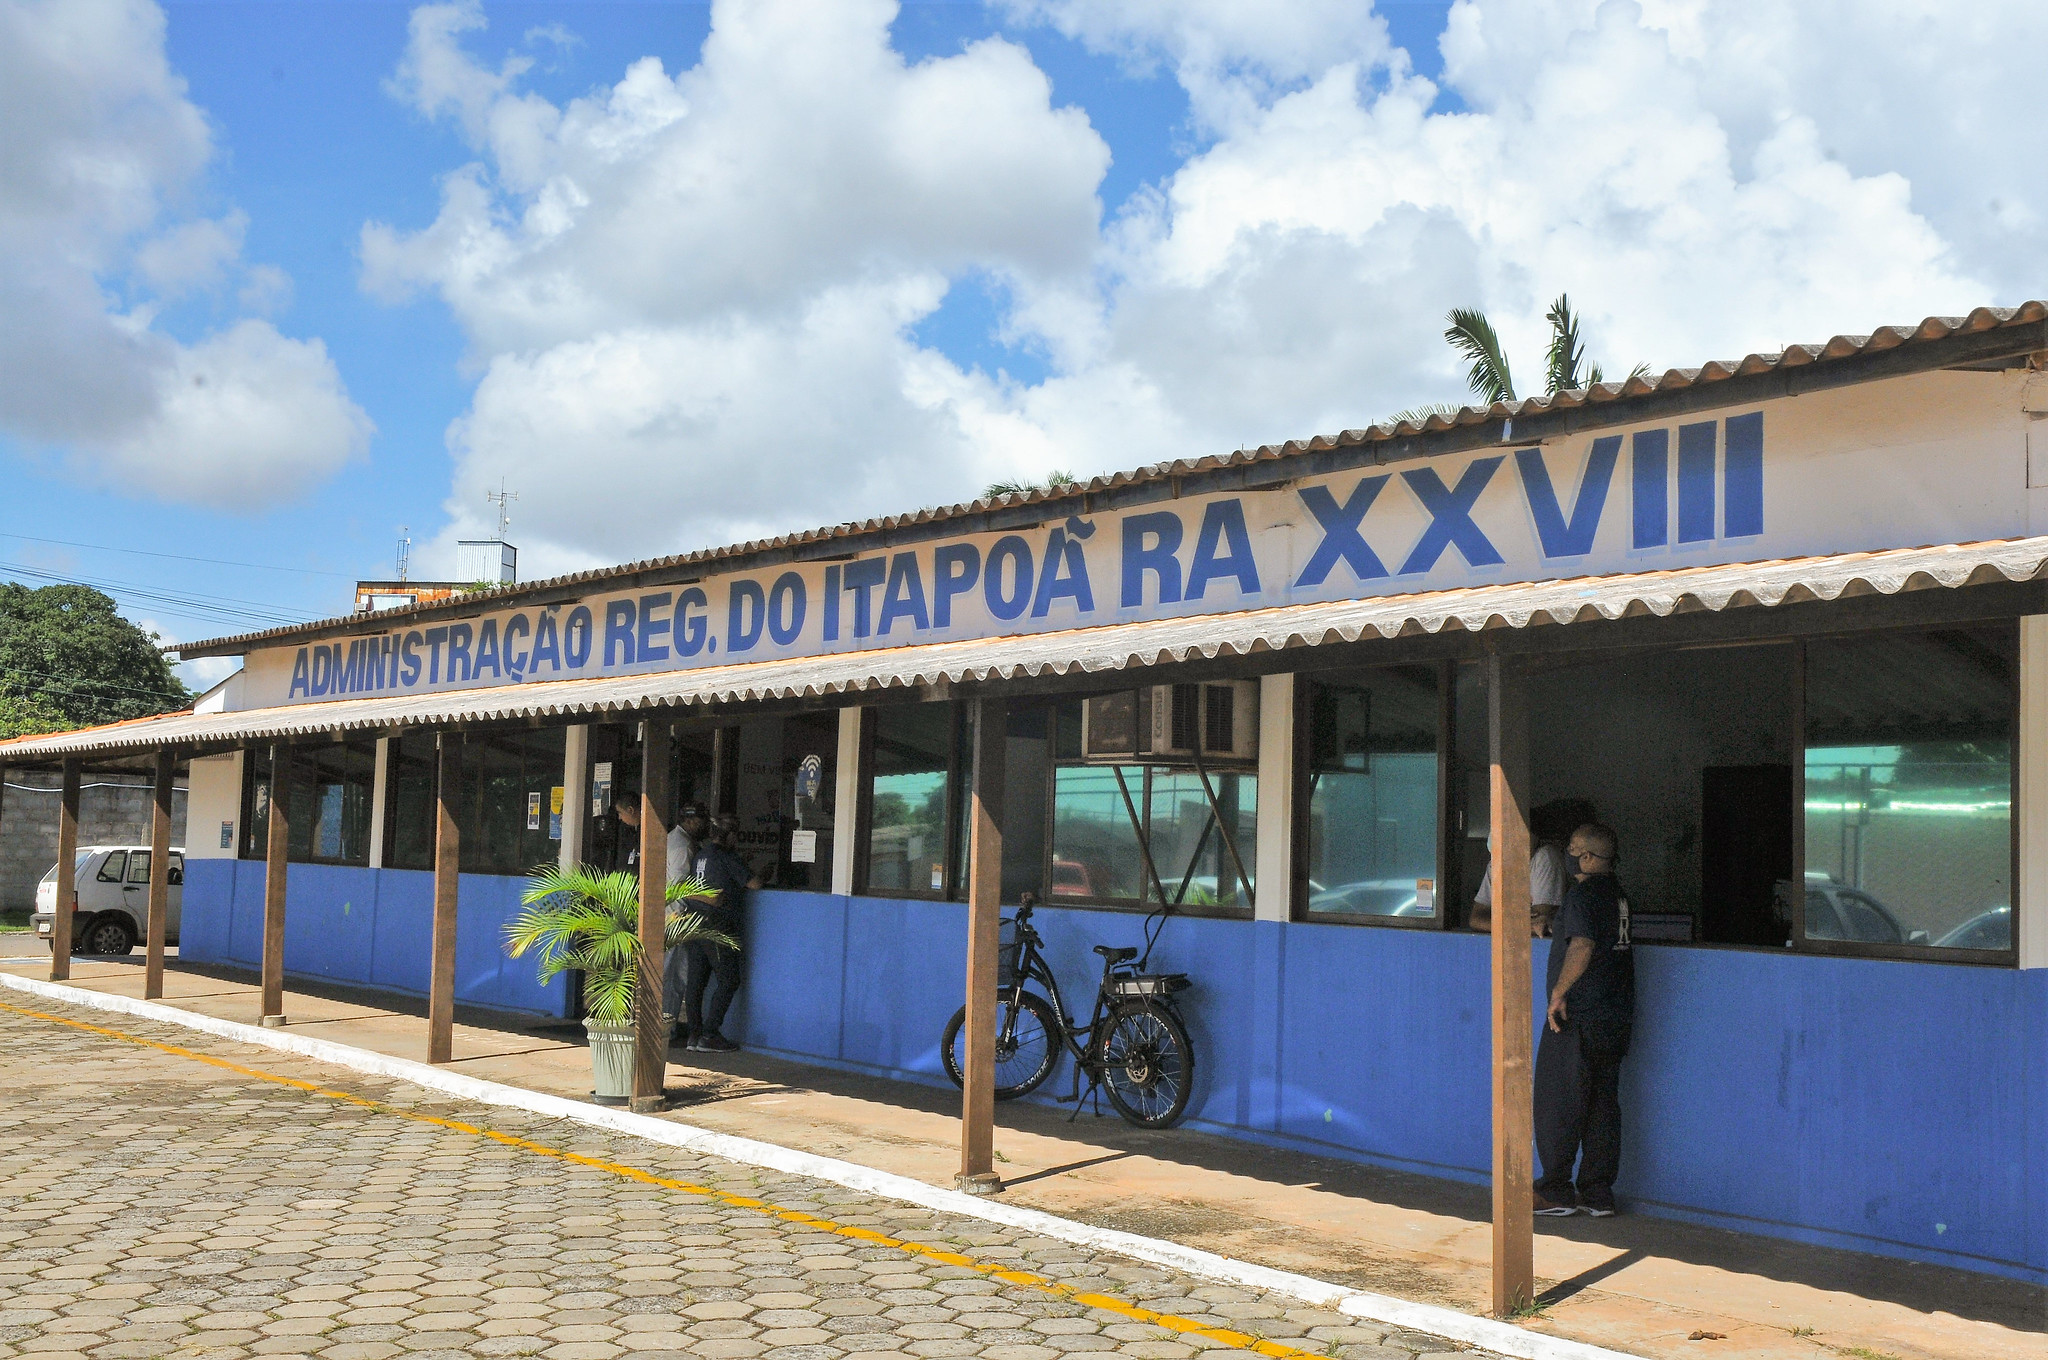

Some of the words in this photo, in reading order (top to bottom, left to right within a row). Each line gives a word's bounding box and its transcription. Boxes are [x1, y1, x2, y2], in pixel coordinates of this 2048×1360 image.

[288, 604, 593, 698] ADMINISTRAÇÃO
[603, 587, 716, 667] REG.
[727, 571, 807, 653] DO
[823, 515, 1097, 642] ITAPOÃ
[1120, 498, 1261, 607] RA
[1293, 410, 1764, 587] XXVIII
